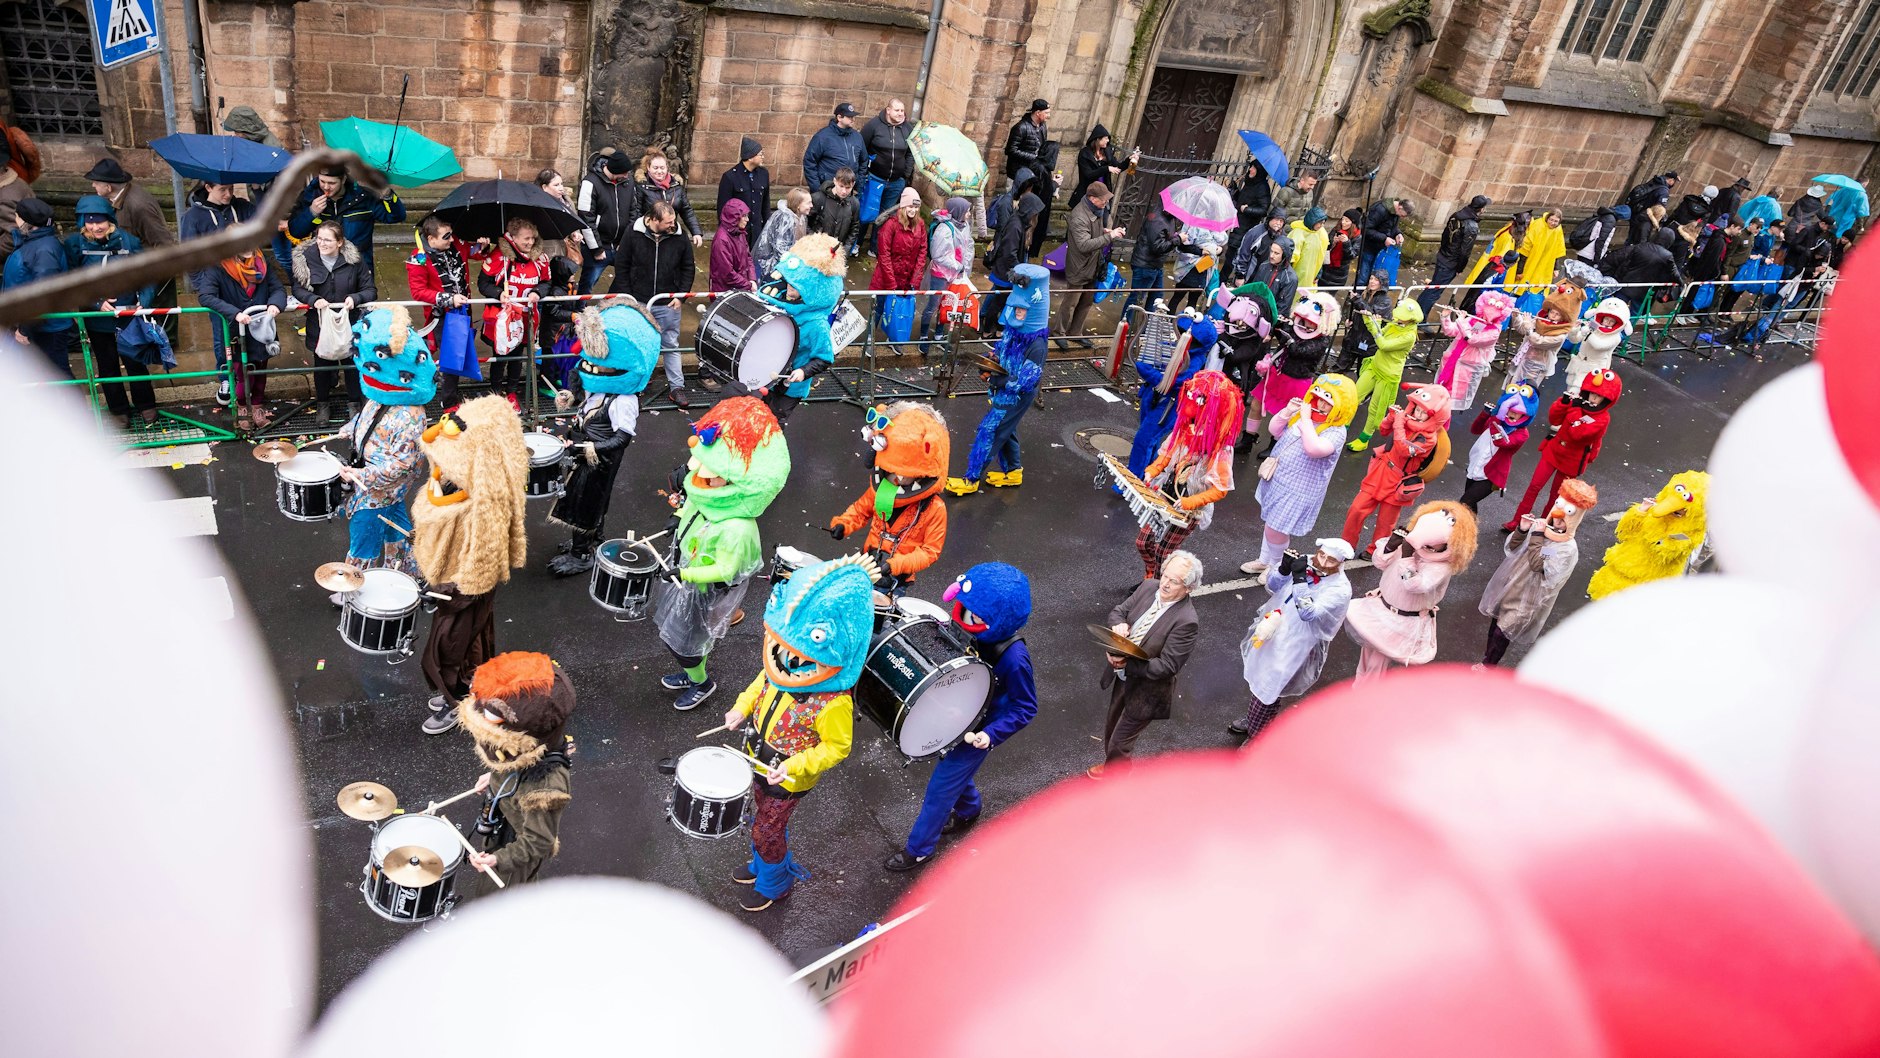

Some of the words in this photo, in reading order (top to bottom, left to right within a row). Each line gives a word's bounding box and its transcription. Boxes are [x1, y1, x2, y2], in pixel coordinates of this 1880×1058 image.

[288, 483, 297, 513] majestic
[886, 652, 915, 680] majestic
[934, 672, 973, 689] majestic
[699, 801, 711, 832] majestic
[398, 887, 418, 916] Pearl
[824, 938, 889, 991] Marti
